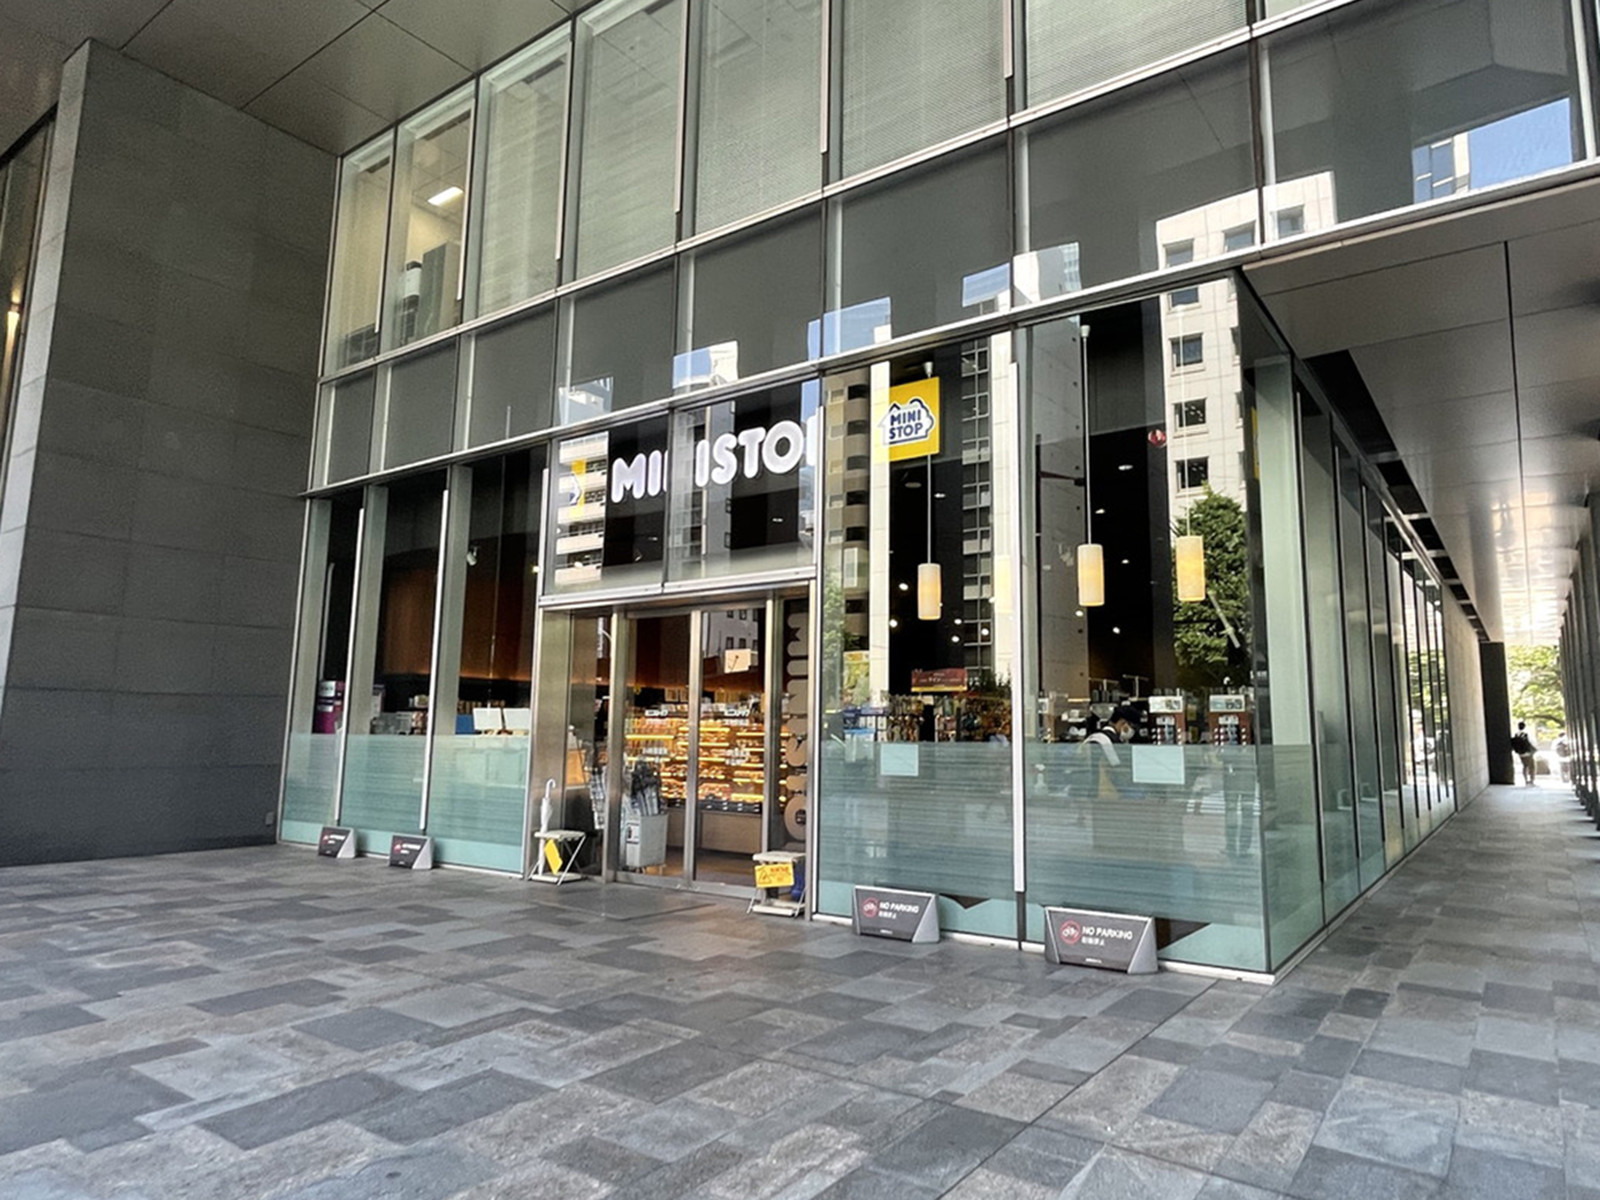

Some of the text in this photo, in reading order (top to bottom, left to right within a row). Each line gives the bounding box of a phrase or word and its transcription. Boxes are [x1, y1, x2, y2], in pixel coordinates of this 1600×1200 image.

[890, 409, 922, 426] MINI
[889, 422, 923, 440] STOP
[611, 415, 817, 503] MIISTO
[1082, 925, 1133, 940] NO PARKING
